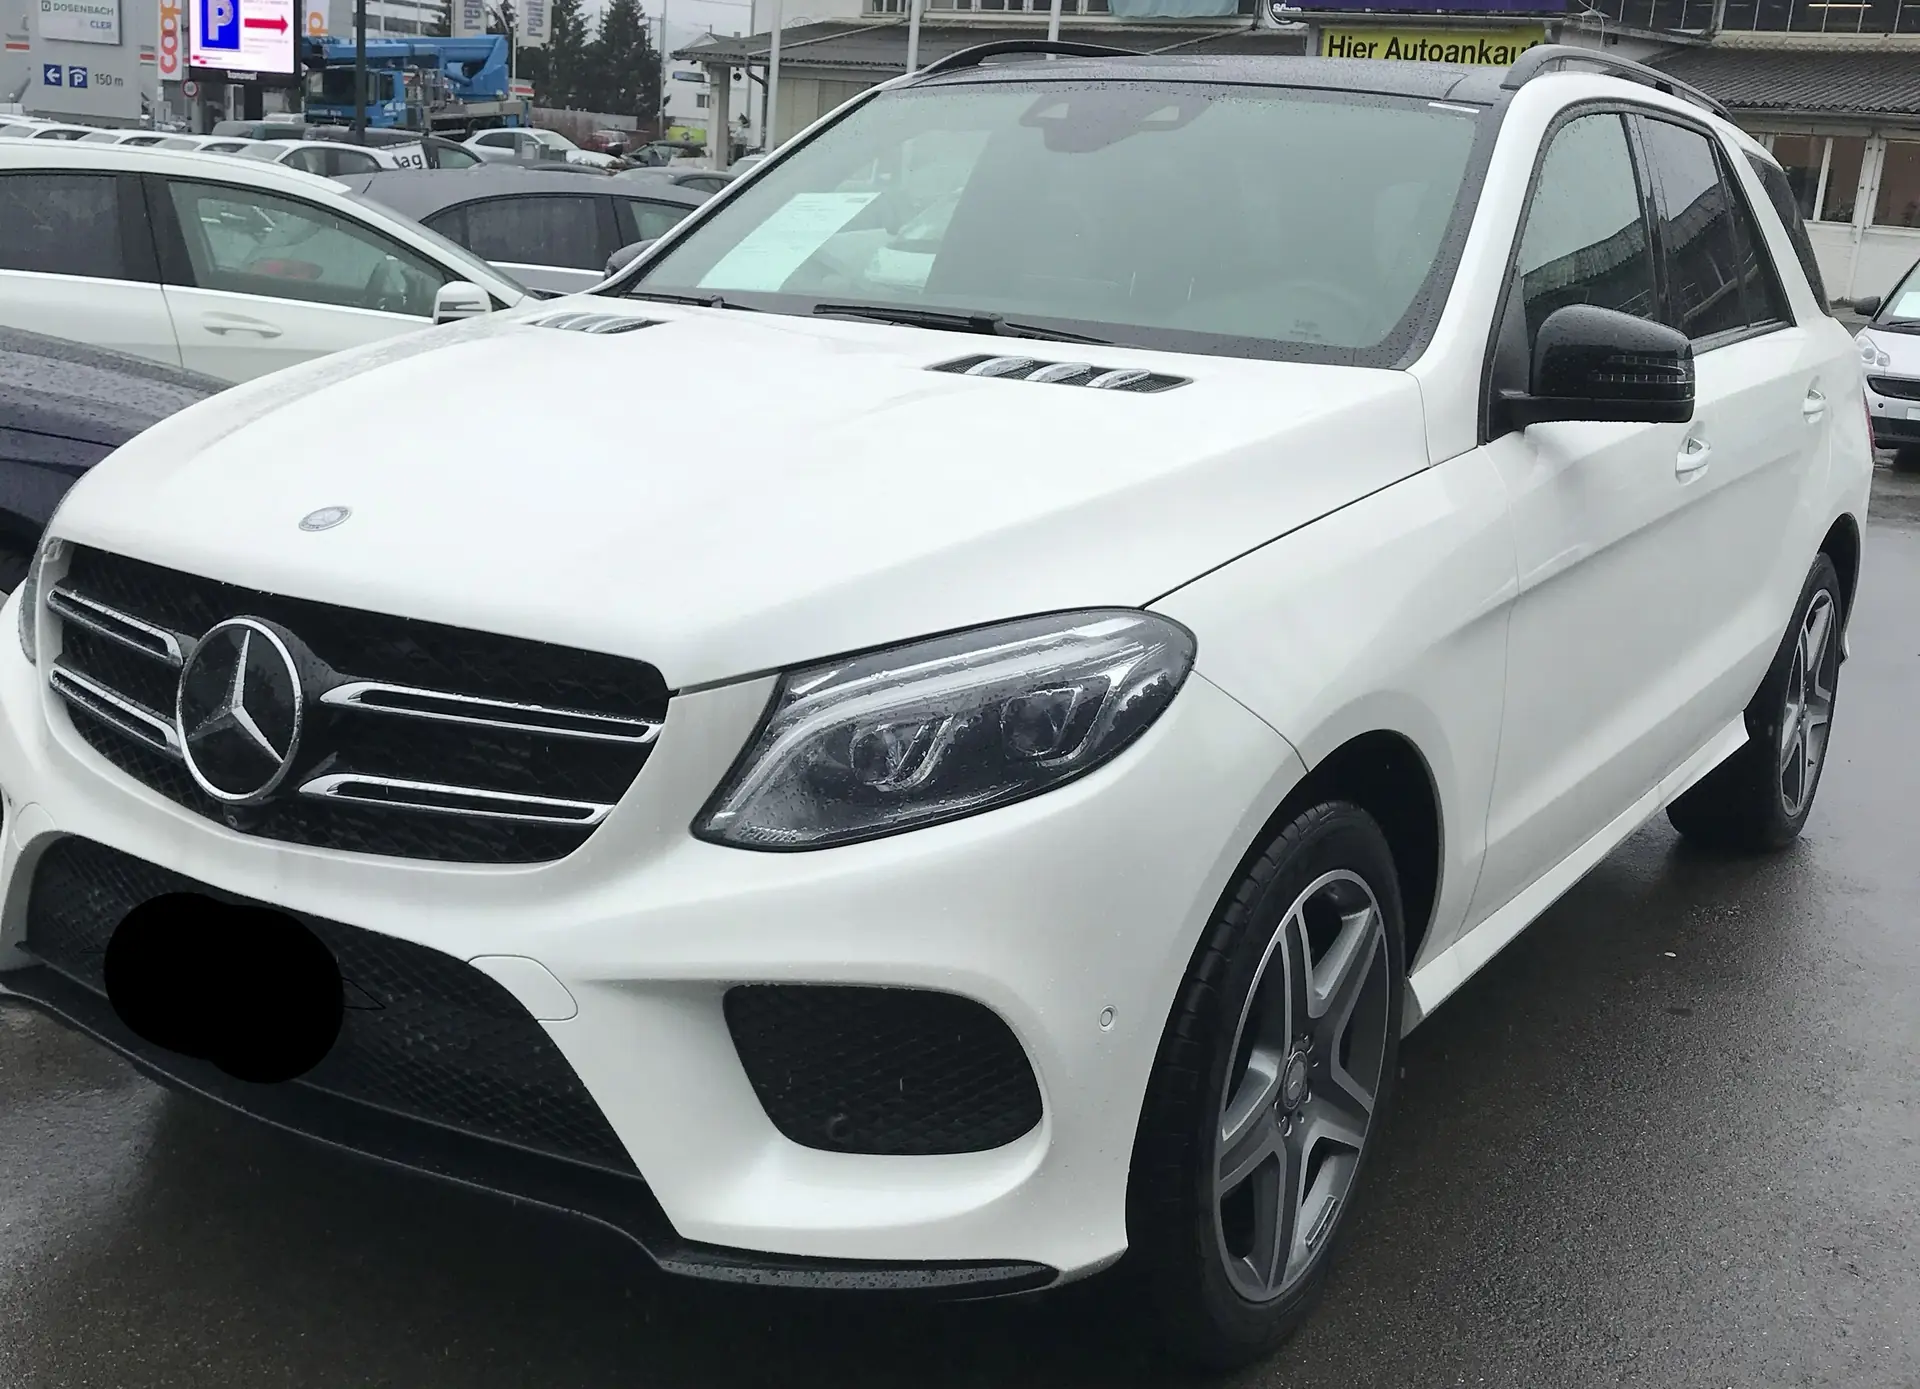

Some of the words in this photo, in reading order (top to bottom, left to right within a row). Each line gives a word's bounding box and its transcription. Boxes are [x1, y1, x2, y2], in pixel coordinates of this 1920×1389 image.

[53, 3, 114, 16] DOSENBACH
[1328, 35, 1378, 58] Hier
[94, 73, 112, 86] 150
[114, 77, 123, 87] m
